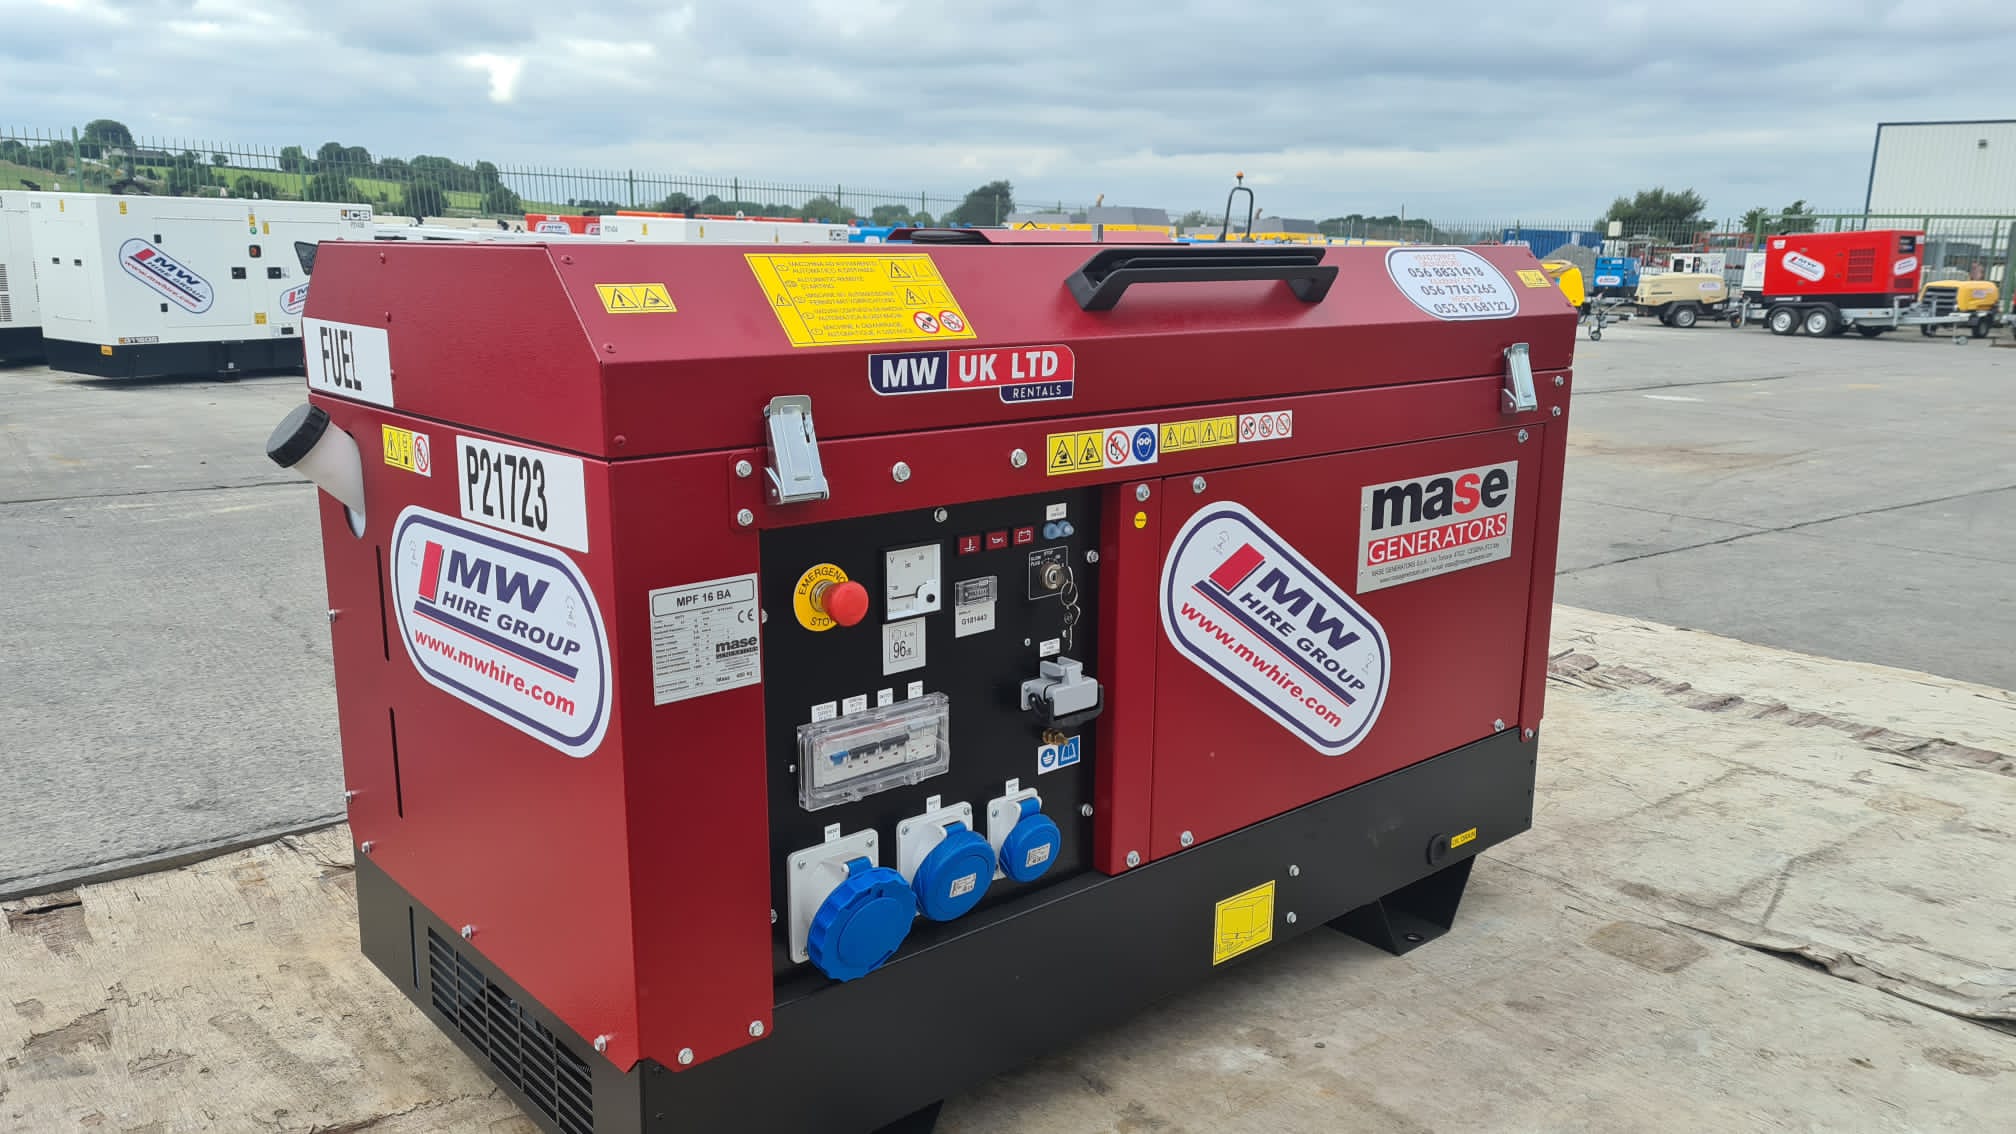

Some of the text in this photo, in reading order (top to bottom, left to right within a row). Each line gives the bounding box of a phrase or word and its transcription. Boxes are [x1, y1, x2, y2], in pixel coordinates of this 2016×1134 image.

[342, 209, 370, 221] JCB
[146, 261, 172, 278] HIRE
[154, 256, 200, 286] MW
[1408, 266, 1484, 278] 056 8831418
[172, 278, 207, 300] GROUP
[1420, 284, 1497, 296] 056 7761265
[1434, 301, 1510, 314] 053 9168122
[319, 326, 362, 391] FUEL
[882, 350, 1059, 388] MW UK LTD
[1012, 384, 1062, 399] RENTALS
[465, 444, 548, 532] P21723
[1371, 468, 1509, 531] mase
[1368, 514, 1507, 563] GENERATORS
[447, 549, 550, 614] MW
[798, 566, 847, 596] EMERGENC
[441, 591, 492, 623] HIRE
[676, 589, 731, 608] MPF 16 BA
[1256, 567, 1361, 651] MW
[1238, 593, 1296, 637] HIRE
[496, 613, 581, 656] GROUP
[715, 636, 758, 653] mase
[893, 640, 906, 659] 96
[414, 629, 576, 716] www.mwhire.com
[1180, 602, 1342, 728] www.mwhire.com
[1296, 637, 1366, 691] GROUP
